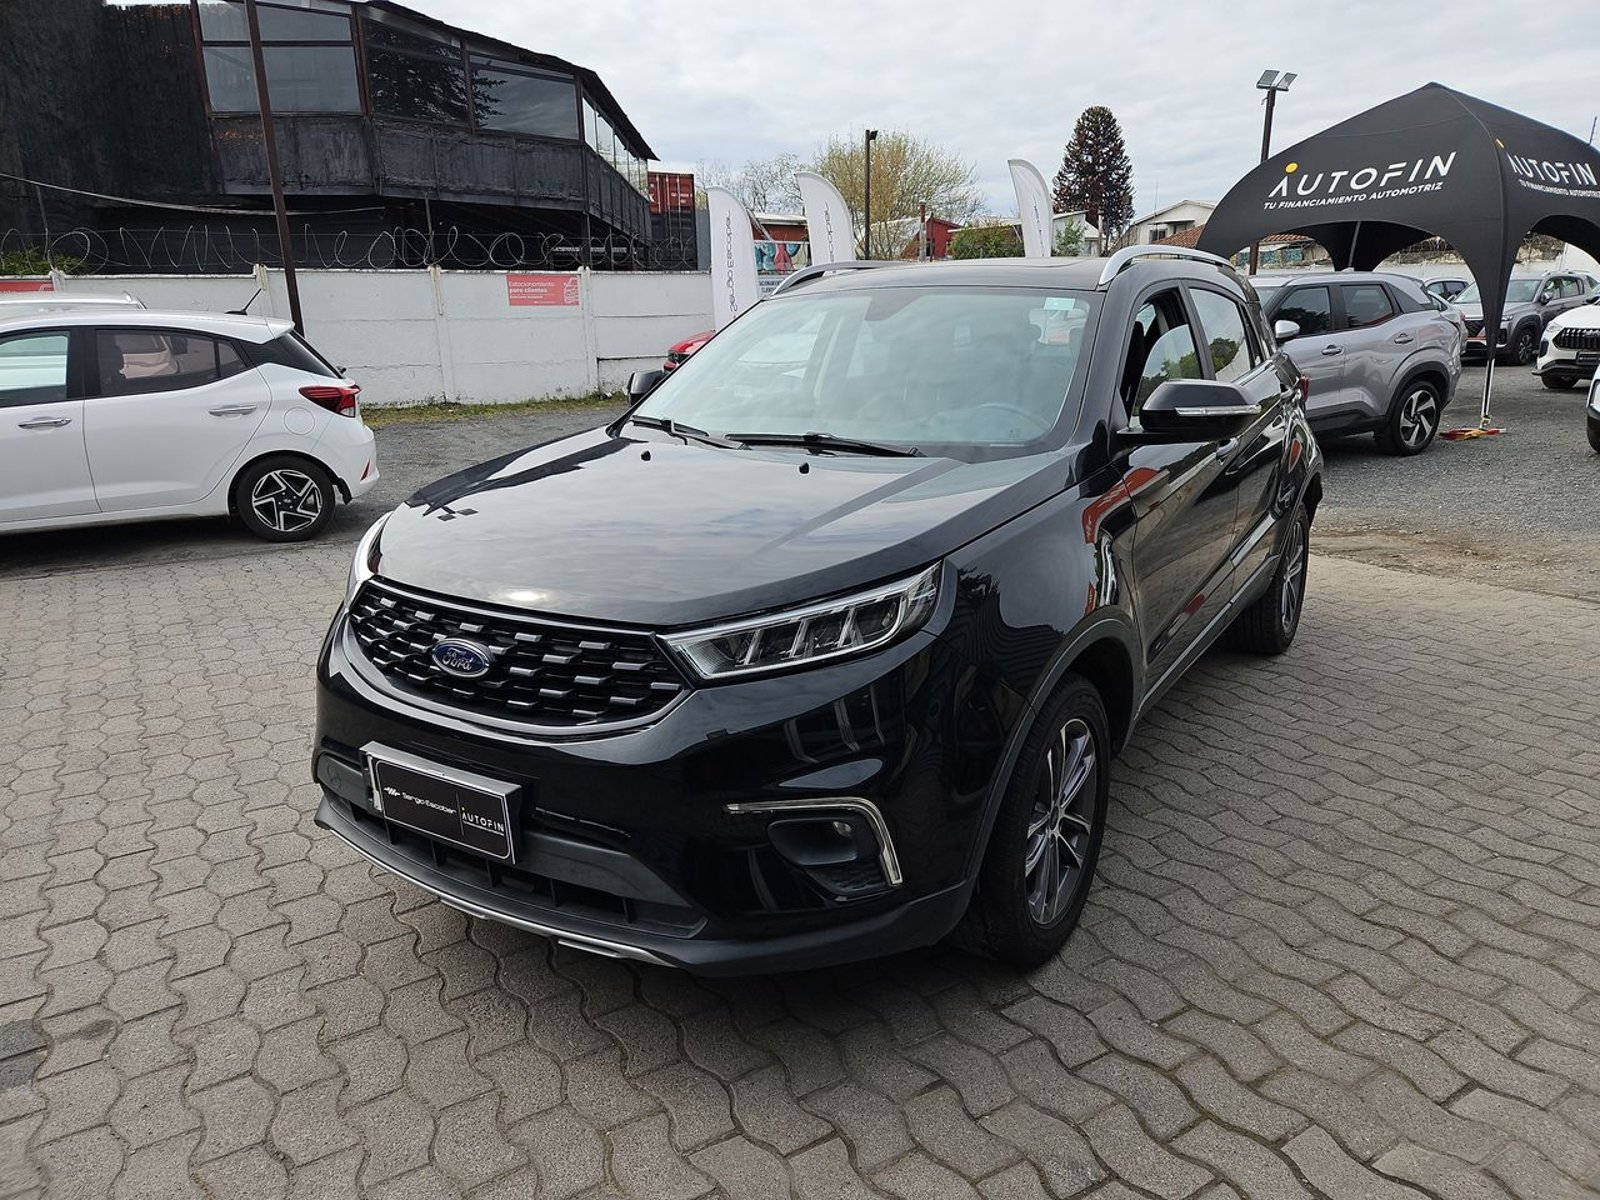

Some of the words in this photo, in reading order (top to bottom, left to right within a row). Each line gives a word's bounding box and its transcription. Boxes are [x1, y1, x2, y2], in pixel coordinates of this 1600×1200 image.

[1268, 151, 1457, 198] AUTOFIN
[1505, 152, 1598, 186] AUTOFIN
[1264, 201, 1277, 210] TU
[1278, 193, 1368, 209] FINANCIAMIENTO
[1369, 181, 1445, 200] AUTOMOTRIZ
[442, 648, 474, 670] Ford
[461, 812, 505, 832] AUTOFIN
